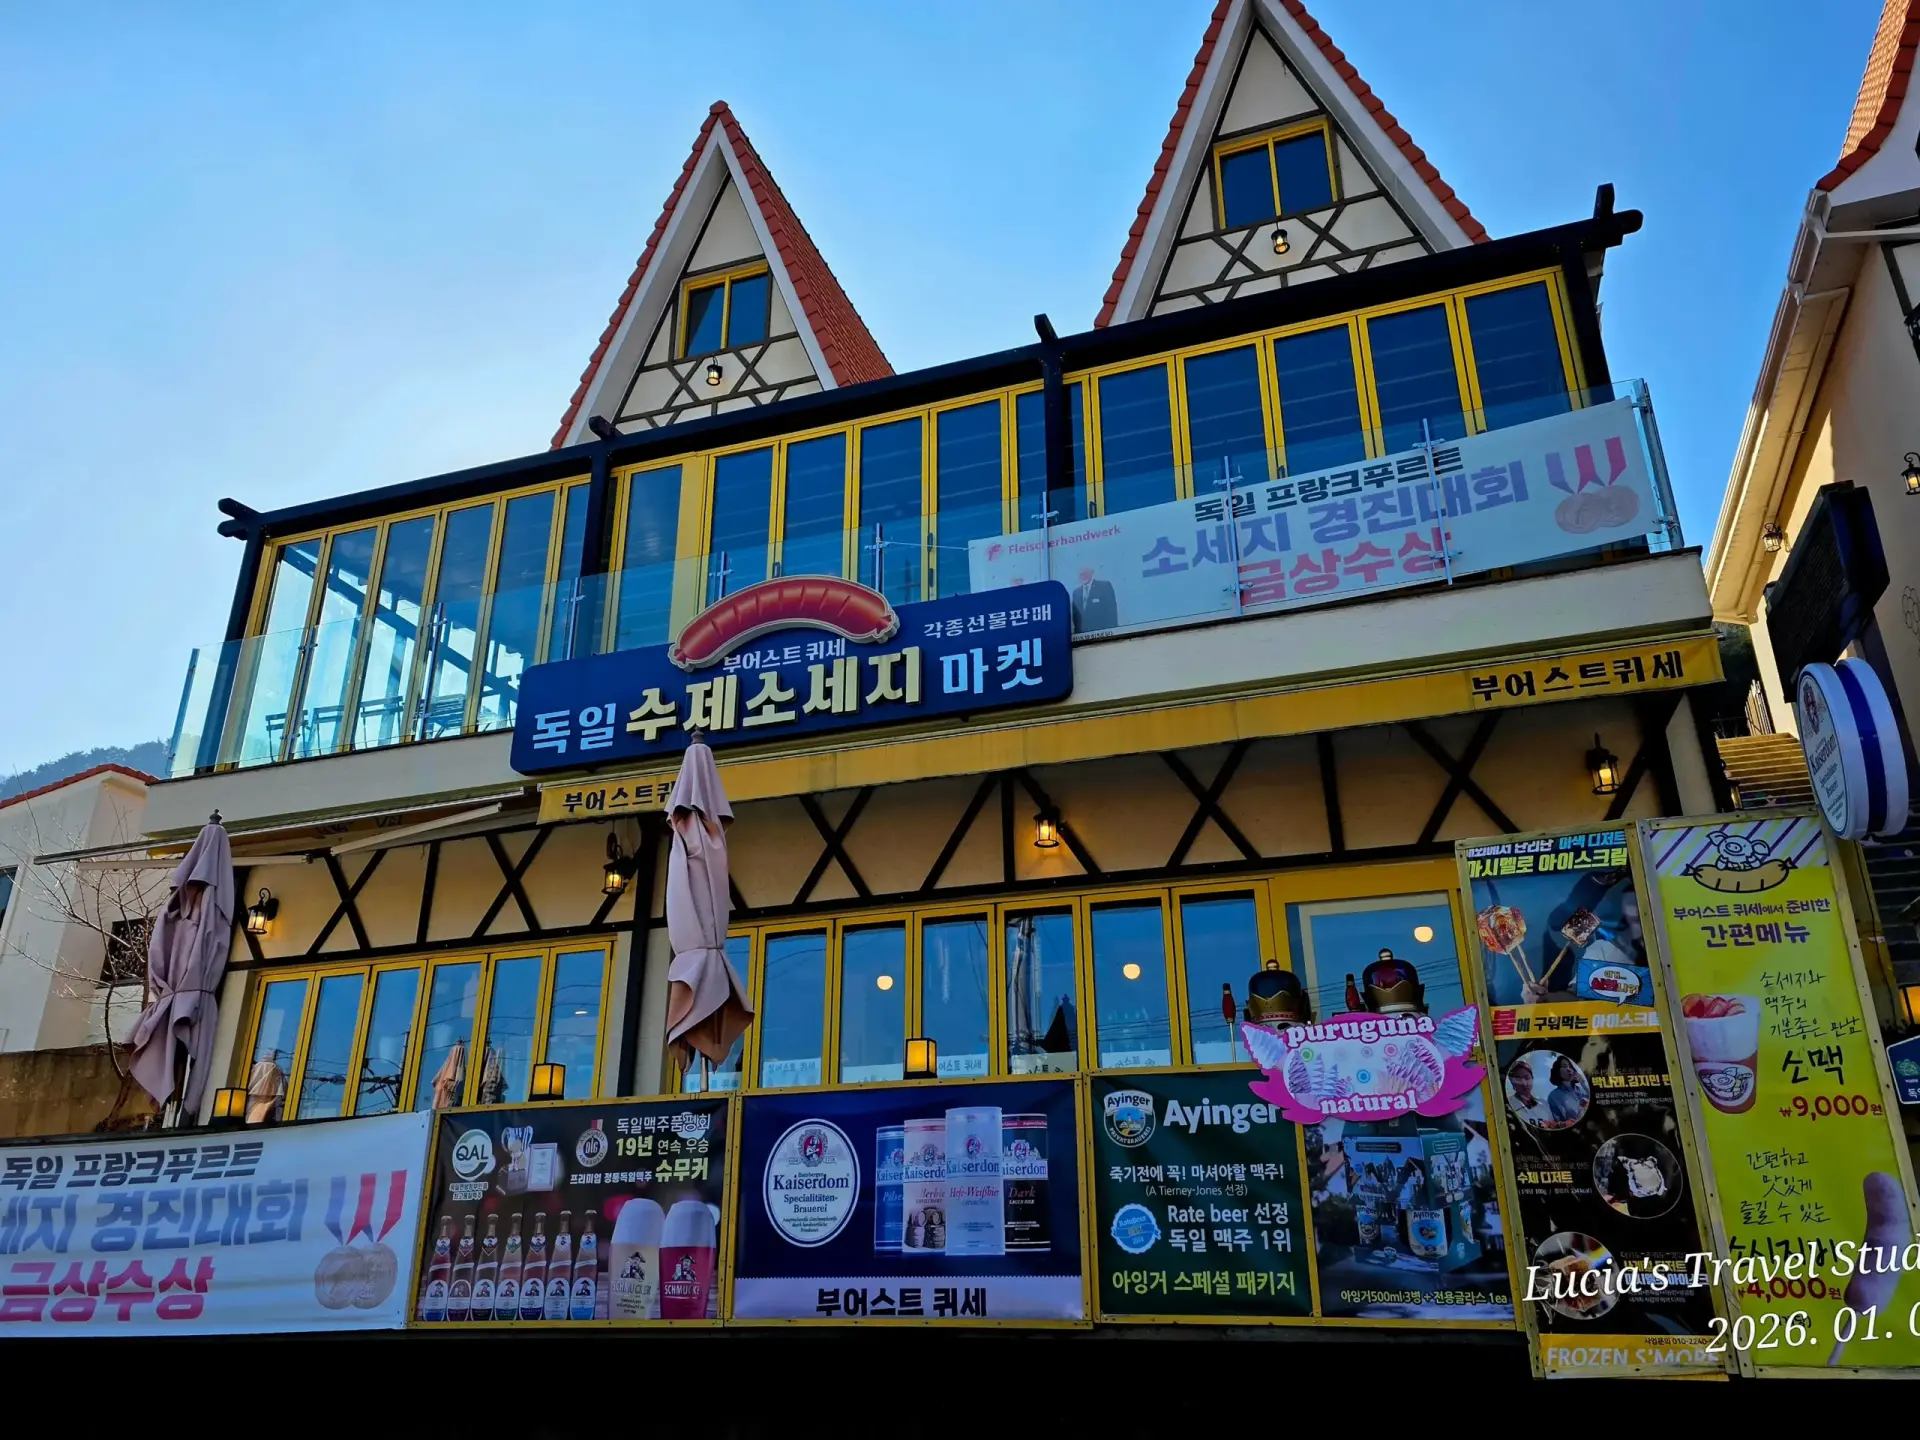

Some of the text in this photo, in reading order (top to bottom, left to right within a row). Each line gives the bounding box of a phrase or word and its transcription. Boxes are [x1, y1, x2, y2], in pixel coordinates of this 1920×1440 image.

[1194, 446, 1462, 522] 독일 프랑크푸르트
[1141, 460, 1528, 578] 소세지 경진대회
[1008, 525, 1121, 555] Fleiscerhandwerk
[1238, 528, 1452, 607] 금상수상
[924, 604, 1052, 639] 각종선물판매
[722, 638, 846, 673] 부어스트 퀴세
[1471, 650, 1685, 712] 부어스트퀴세
[532, 638, 1043, 754] 독일 수제소세지 마켓
[1559, 835, 1585, 849] 이색
[1588, 831, 1627, 845] 디저트
[1467, 848, 1628, 878] 마시멜로 아이스크림
[1674, 898, 1831, 920] 부어스트 퀴세에서 준비한
[1701, 921, 1811, 948] 간편메뉴
[1760, 969, 1826, 989] 소세지와
[1765, 996, 1807, 1017] 맥주의
[1534, 1016, 1588, 1031] 구워먹는
[1771, 1017, 1828, 1041] 기분좋은
[1782, 1045, 1844, 1086] 소맥
[1108, 1093, 1150, 1107] Ayinger
[1320, 1090, 1418, 1115] natural
[617, 1113, 711, 1134] 독일맥주품평회
[1163, 1098, 1281, 1134] Ayinger
[456, 1144, 489, 1162] QAL
[616, 1135, 709, 1157] 19년 연속 우승
[0, 1141, 264, 1190] 독일 프랑크푸르트
[1746, 1147, 1809, 1170] 간편하고
[570, 1173, 602, 1185] 프리미엄
[655, 1157, 709, 1183] 슈무커
[773, 1174, 850, 1190] Kaiserdom
[1109, 1163, 1284, 1182] 죽기전에 꼭! 마셔야할 맥주!
[1517, 1171, 1573, 1184] 수제 디저트
[950, 1186, 1000, 1200] Hefe-Weißbier
[1007, 1186, 1036, 1198] Dark
[1146, 1184, 1248, 1197] (A Tierney-Jones 선정)
[1762, 1174, 1812, 1197] 맛있게
[783, 1193, 838, 1205] Specialitäten-
[793, 1204, 827, 1213] Brauerei
[90, 1178, 309, 1252] 경진대회
[1168, 1203, 1289, 1225] Rate beer 선정
[1740, 1200, 1831, 1225] 즐길 수 있는
[1169, 1228, 1292, 1252] 독일 맥주 1위
[0, 1257, 215, 1322] 금상수상
[1112, 1270, 1296, 1296] 아잉거 스페셜 패키지
[816, 1287, 987, 1316] 부어스트 퀴세
[1433, 1290, 1487, 1304] 전용글라스
[1489, 1292, 1508, 1304] 1ea
[1547, 1347, 1628, 1367] FROZEN
